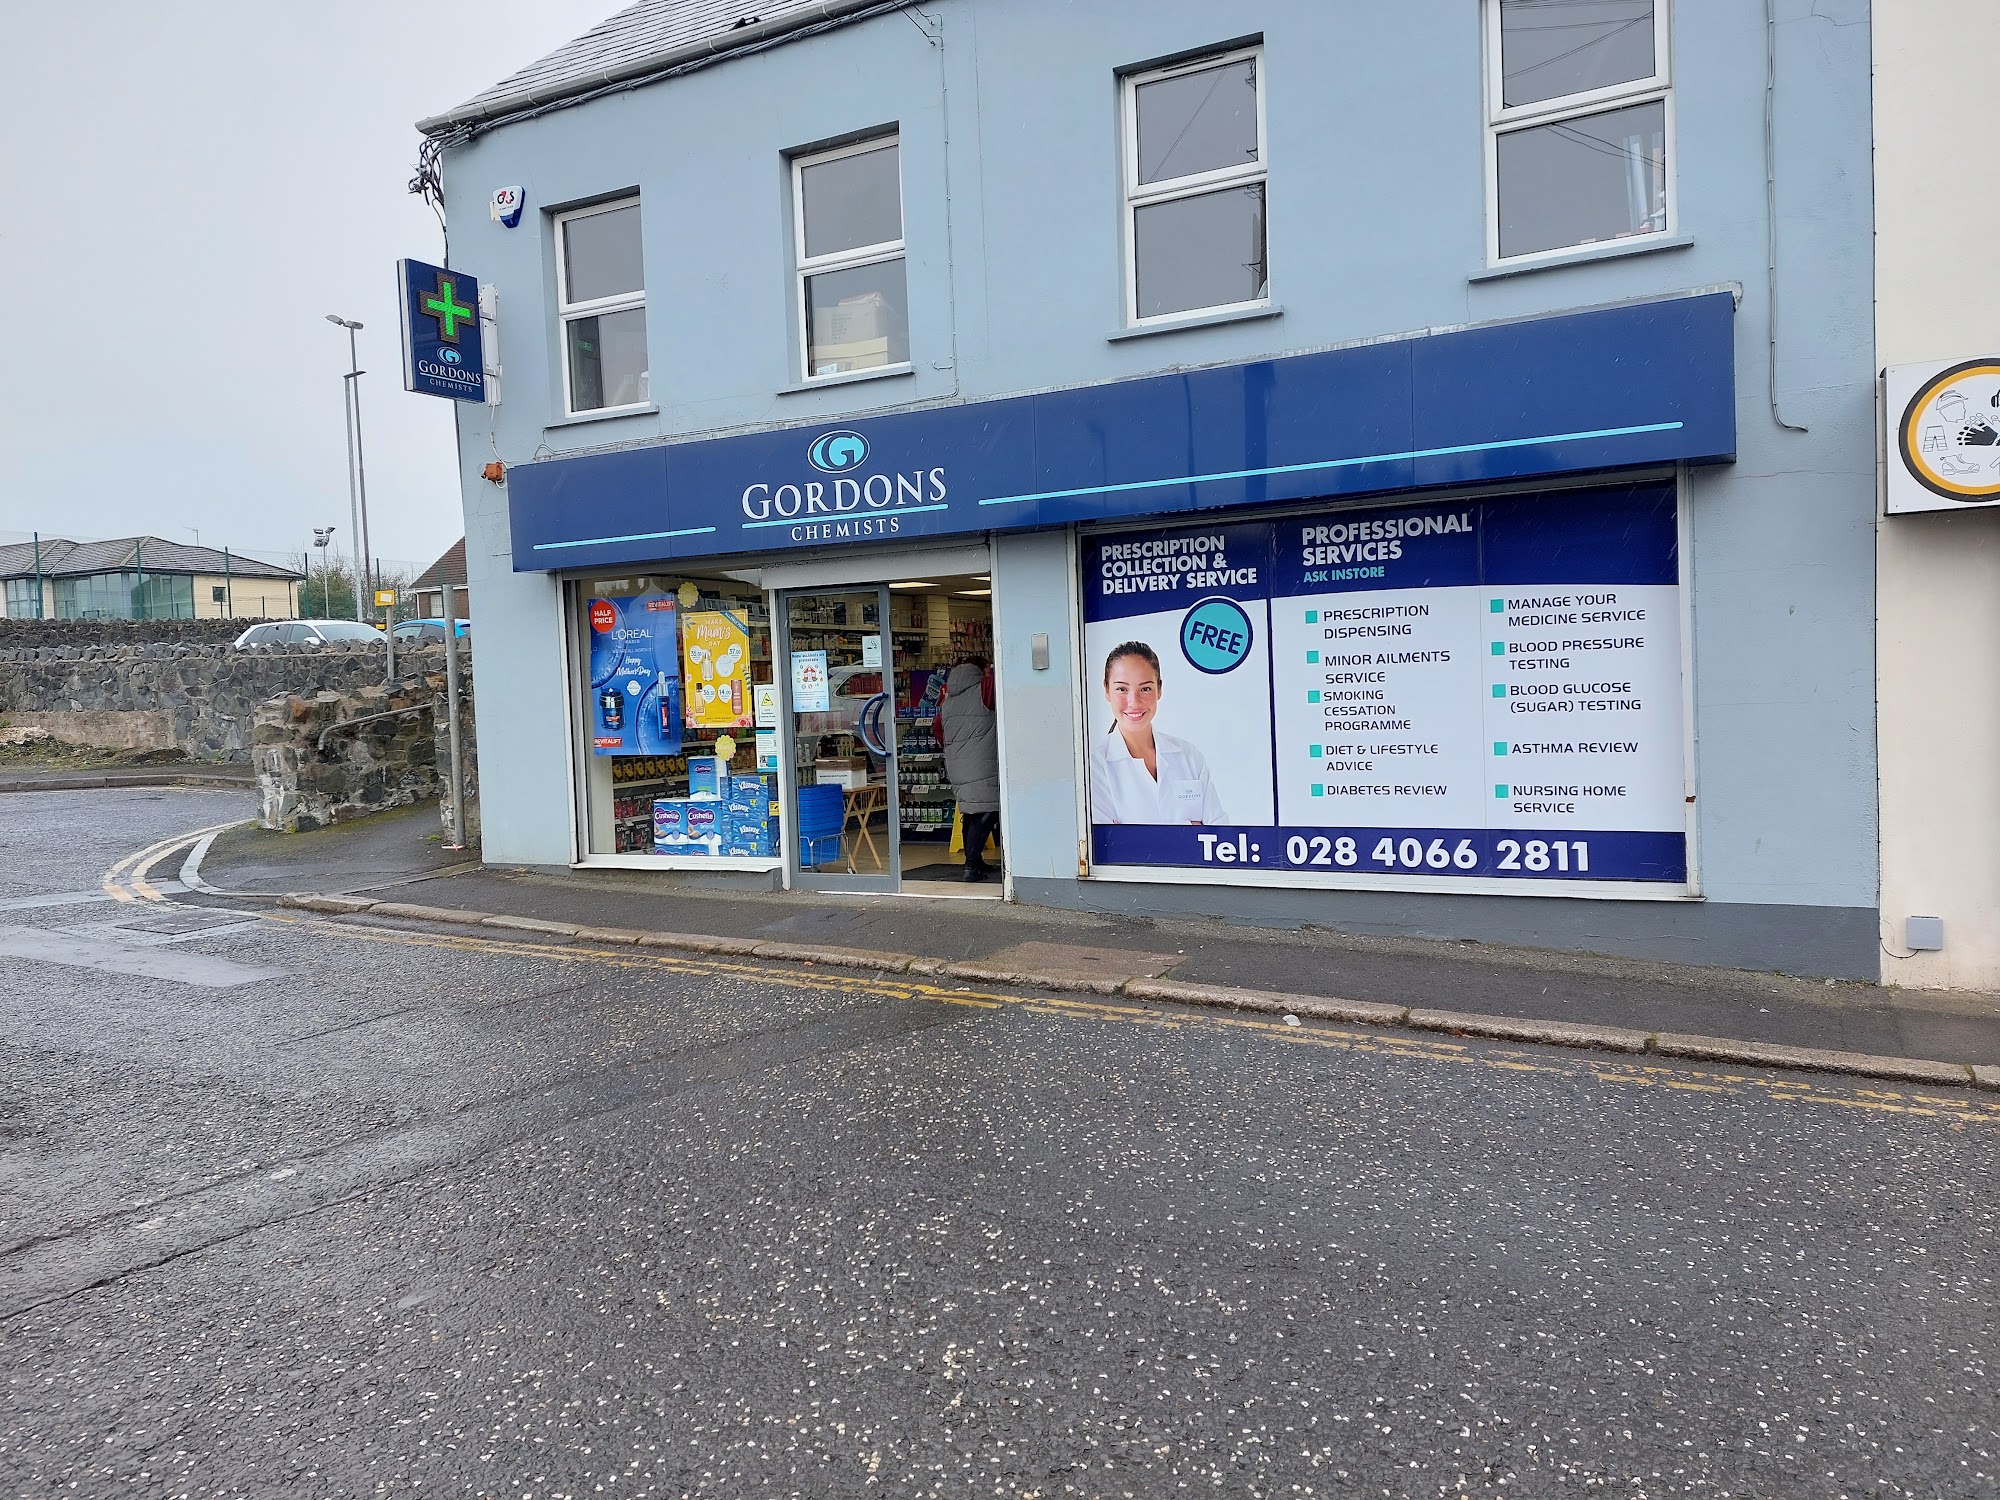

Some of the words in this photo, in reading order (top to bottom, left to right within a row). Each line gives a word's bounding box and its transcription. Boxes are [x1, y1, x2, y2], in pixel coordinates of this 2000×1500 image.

[418, 360, 481, 383] GORDONS
[430, 379, 473, 392] CHEMISTS
[741, 467, 947, 520] GORDONS
[791, 517, 900, 541] CHEMISTS
[1302, 513, 1473, 546] PROFESSIONAL
[1101, 535, 1225, 561] PRESCRIPTION
[1302, 540, 1403, 566] SERVICES
[1101, 554, 1207, 578] COLLECTION
[1212, 552, 1228, 568] &
[1102, 573, 1181, 595] DELIVERY
[1186, 567, 1258, 589] SERVICE
[1303, 570, 1328, 583] ASK
[1331, 566, 1385, 580] INSTORE
[1508, 596, 1571, 610] MANAGE
[1575, 593, 1617, 606] YOUR
[594, 609, 612, 617] HALF
[1323, 604, 1429, 621] PRESCRIPTION
[1508, 613, 1577, 627] MEDICINE
[1581, 610, 1646, 623] SERVICE
[696, 624, 732, 641] Mum's
[1190, 620, 1243, 655] FREE
[1324, 624, 1412, 639] DISPENSING
[1509, 641, 1558, 653] BLOOD
[1562, 637, 1645, 651] PRESSURE
[625, 656, 641, 666] Happy
[1325, 654, 1372, 666] MINOR
[1376, 651, 1451, 664] AILMENTS
[1509, 658, 1570, 670] TESTING
[1325, 672, 1386, 684] SERVICE
[1323, 690, 1384, 701] SMOKING
[1510, 684, 1558, 696] BLOOD
[1563, 682, 1632, 694] GLUCOSE
[1324, 705, 1396, 717] CESSATION
[1510, 700, 1574, 714] (SUGAR)
[1578, 700, 1641, 711] TESTING
[1325, 720, 1411, 731] PROGRAMME
[1326, 745, 1354, 755] DIET
[1357, 746, 1367, 755] &
[1370, 744, 1439, 754] LIFESTYLE
[1512, 743, 1574, 754] ASTHMA
[1578, 742, 1639, 753] REVIEW
[1326, 761, 1373, 771] ADVICE
[739, 781, 760, 791] Kleenex
[1327, 785, 1390, 795] DIABETES
[1394, 785, 1447, 795] REVIEW
[1513, 785, 1579, 796] NURSING
[1583, 785, 1627, 796] HOME
[729, 803, 750, 812] Kleenex
[1513, 802, 1575, 813] SERVICE
[654, 811, 679, 820] Cushelle
[688, 811, 714, 820] Cushelle
[739, 825, 760, 835] Kleenex
[729, 846, 750, 856] Kleenex
[1197, 833, 1261, 863] Tel:
[1286, 835, 1358, 866] 028
[1372, 837, 1478, 869] 4066
[1496, 839, 1589, 872] 2811
